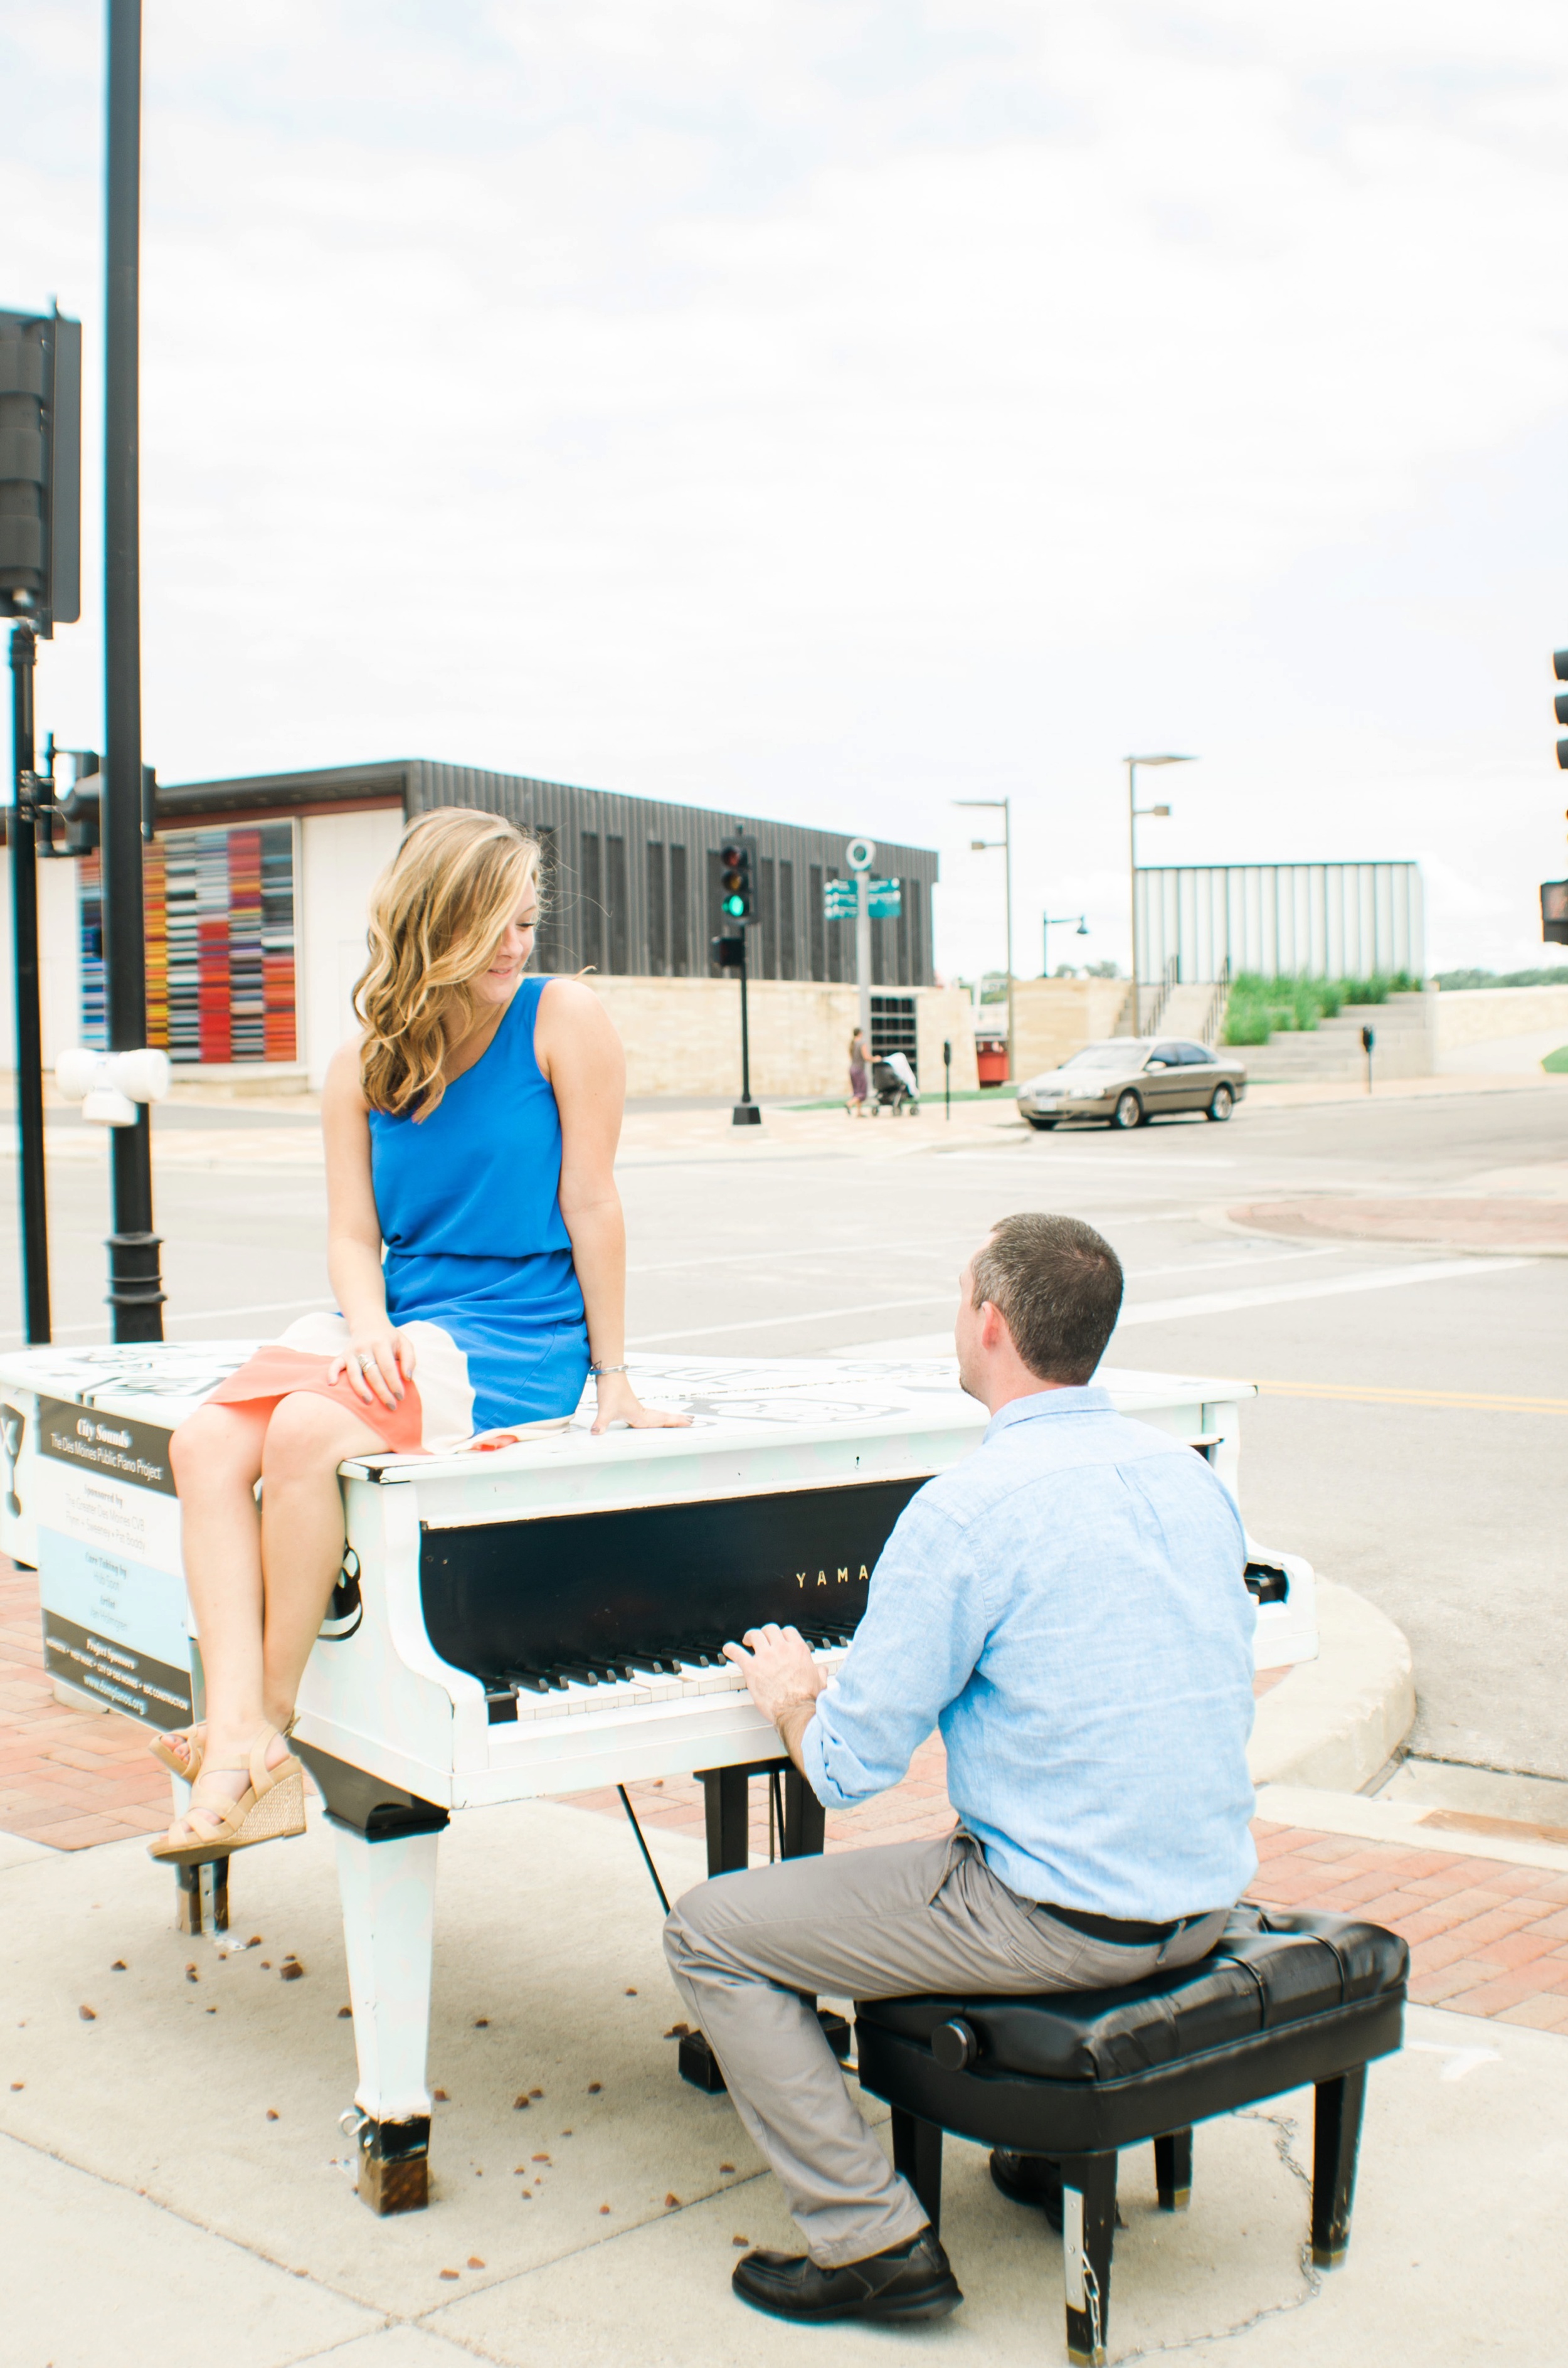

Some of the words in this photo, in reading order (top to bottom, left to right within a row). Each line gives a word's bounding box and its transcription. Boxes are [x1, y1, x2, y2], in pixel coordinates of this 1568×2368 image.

[77, 1418, 95, 1442] City
[96, 1423, 133, 1448] Sounds
[51, 1433, 62, 1448] The
[63, 1437, 74, 1453] Des
[75, 1441, 97, 1461] Moines
[97, 1447, 117, 1467] Public
[117, 1453, 135, 1472] Piano
[137, 1458, 162, 1481] Project
[98, 1505, 108, 1520] Des
[110, 1509, 130, 1527] Moines
[796, 1564, 869, 1588] YAMA
[87, 1636, 107, 1657] Project
[107, 1647, 137, 1670] Sponsors
